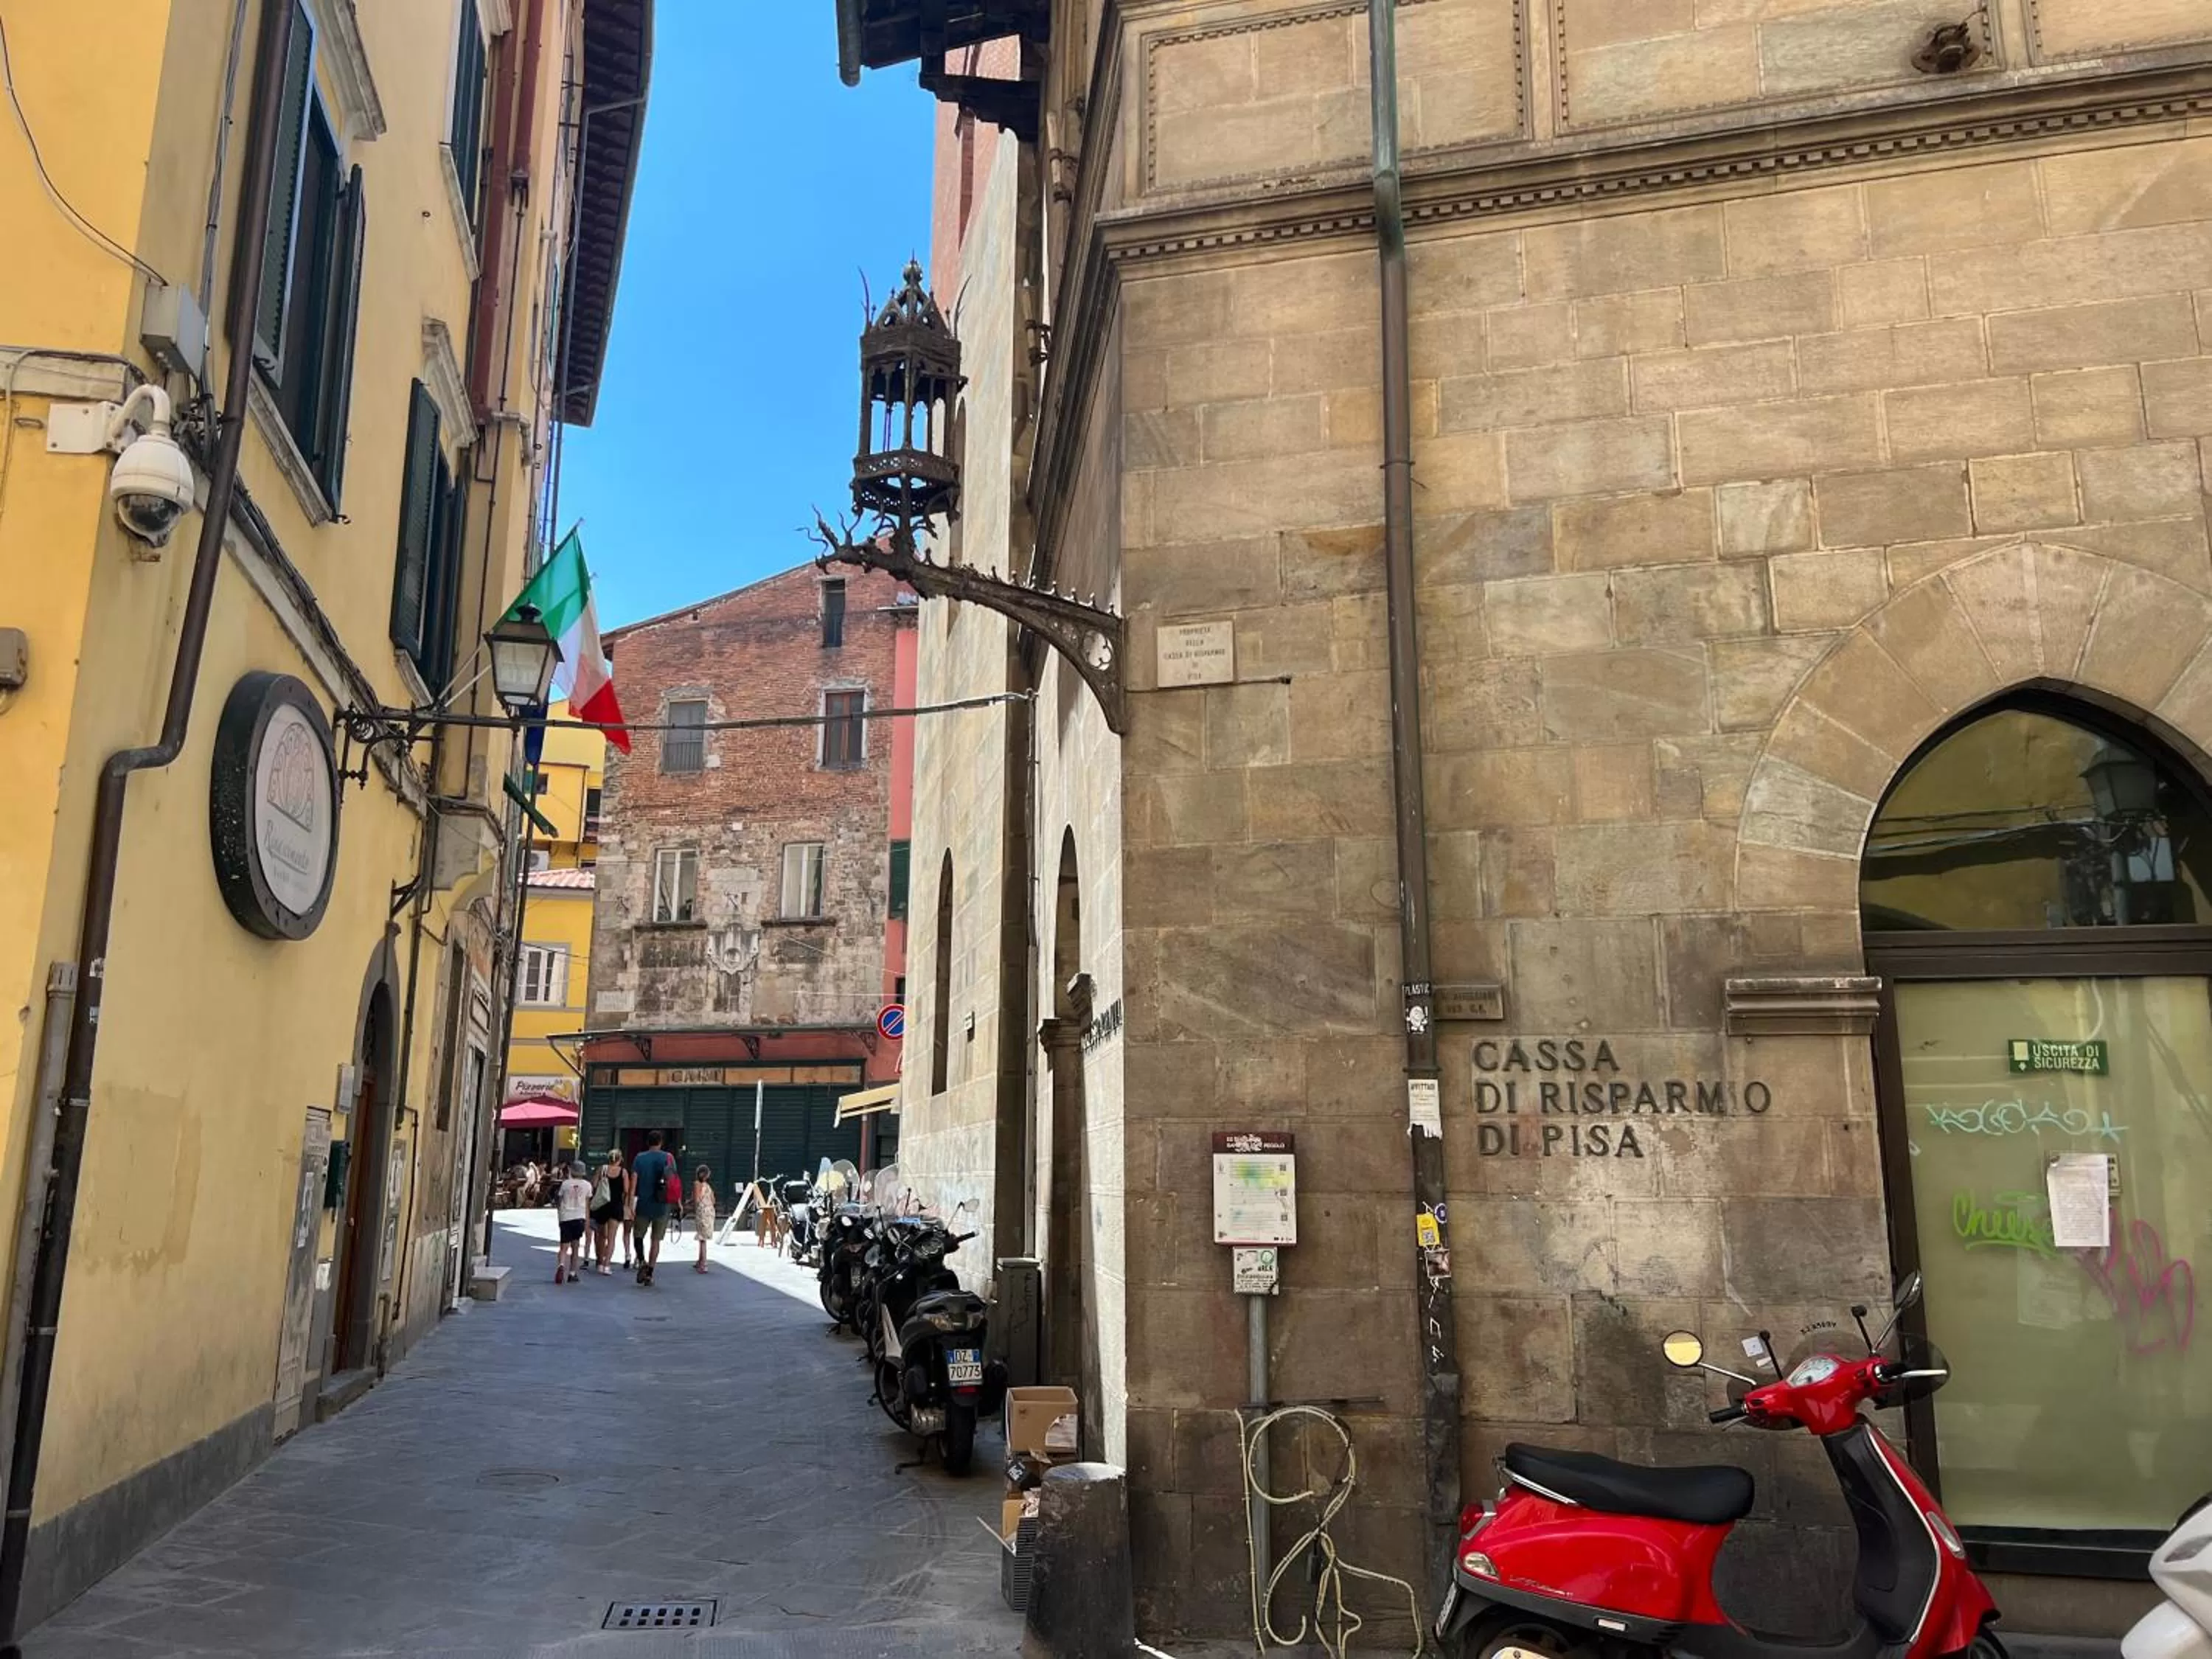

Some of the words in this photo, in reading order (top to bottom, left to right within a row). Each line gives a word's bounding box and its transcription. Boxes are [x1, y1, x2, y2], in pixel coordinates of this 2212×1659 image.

[1474, 1038, 1620, 1072] CASSA
[2032, 1044, 2079, 1057] USCITA
[2086, 1045, 2099, 1057] DI
[2034, 1057, 2101, 1070] SICUREZZA
[1476, 1080, 1517, 1114] DI
[1478, 1124, 1520, 1157] DI
[1543, 1124, 1644, 1158] PISA
